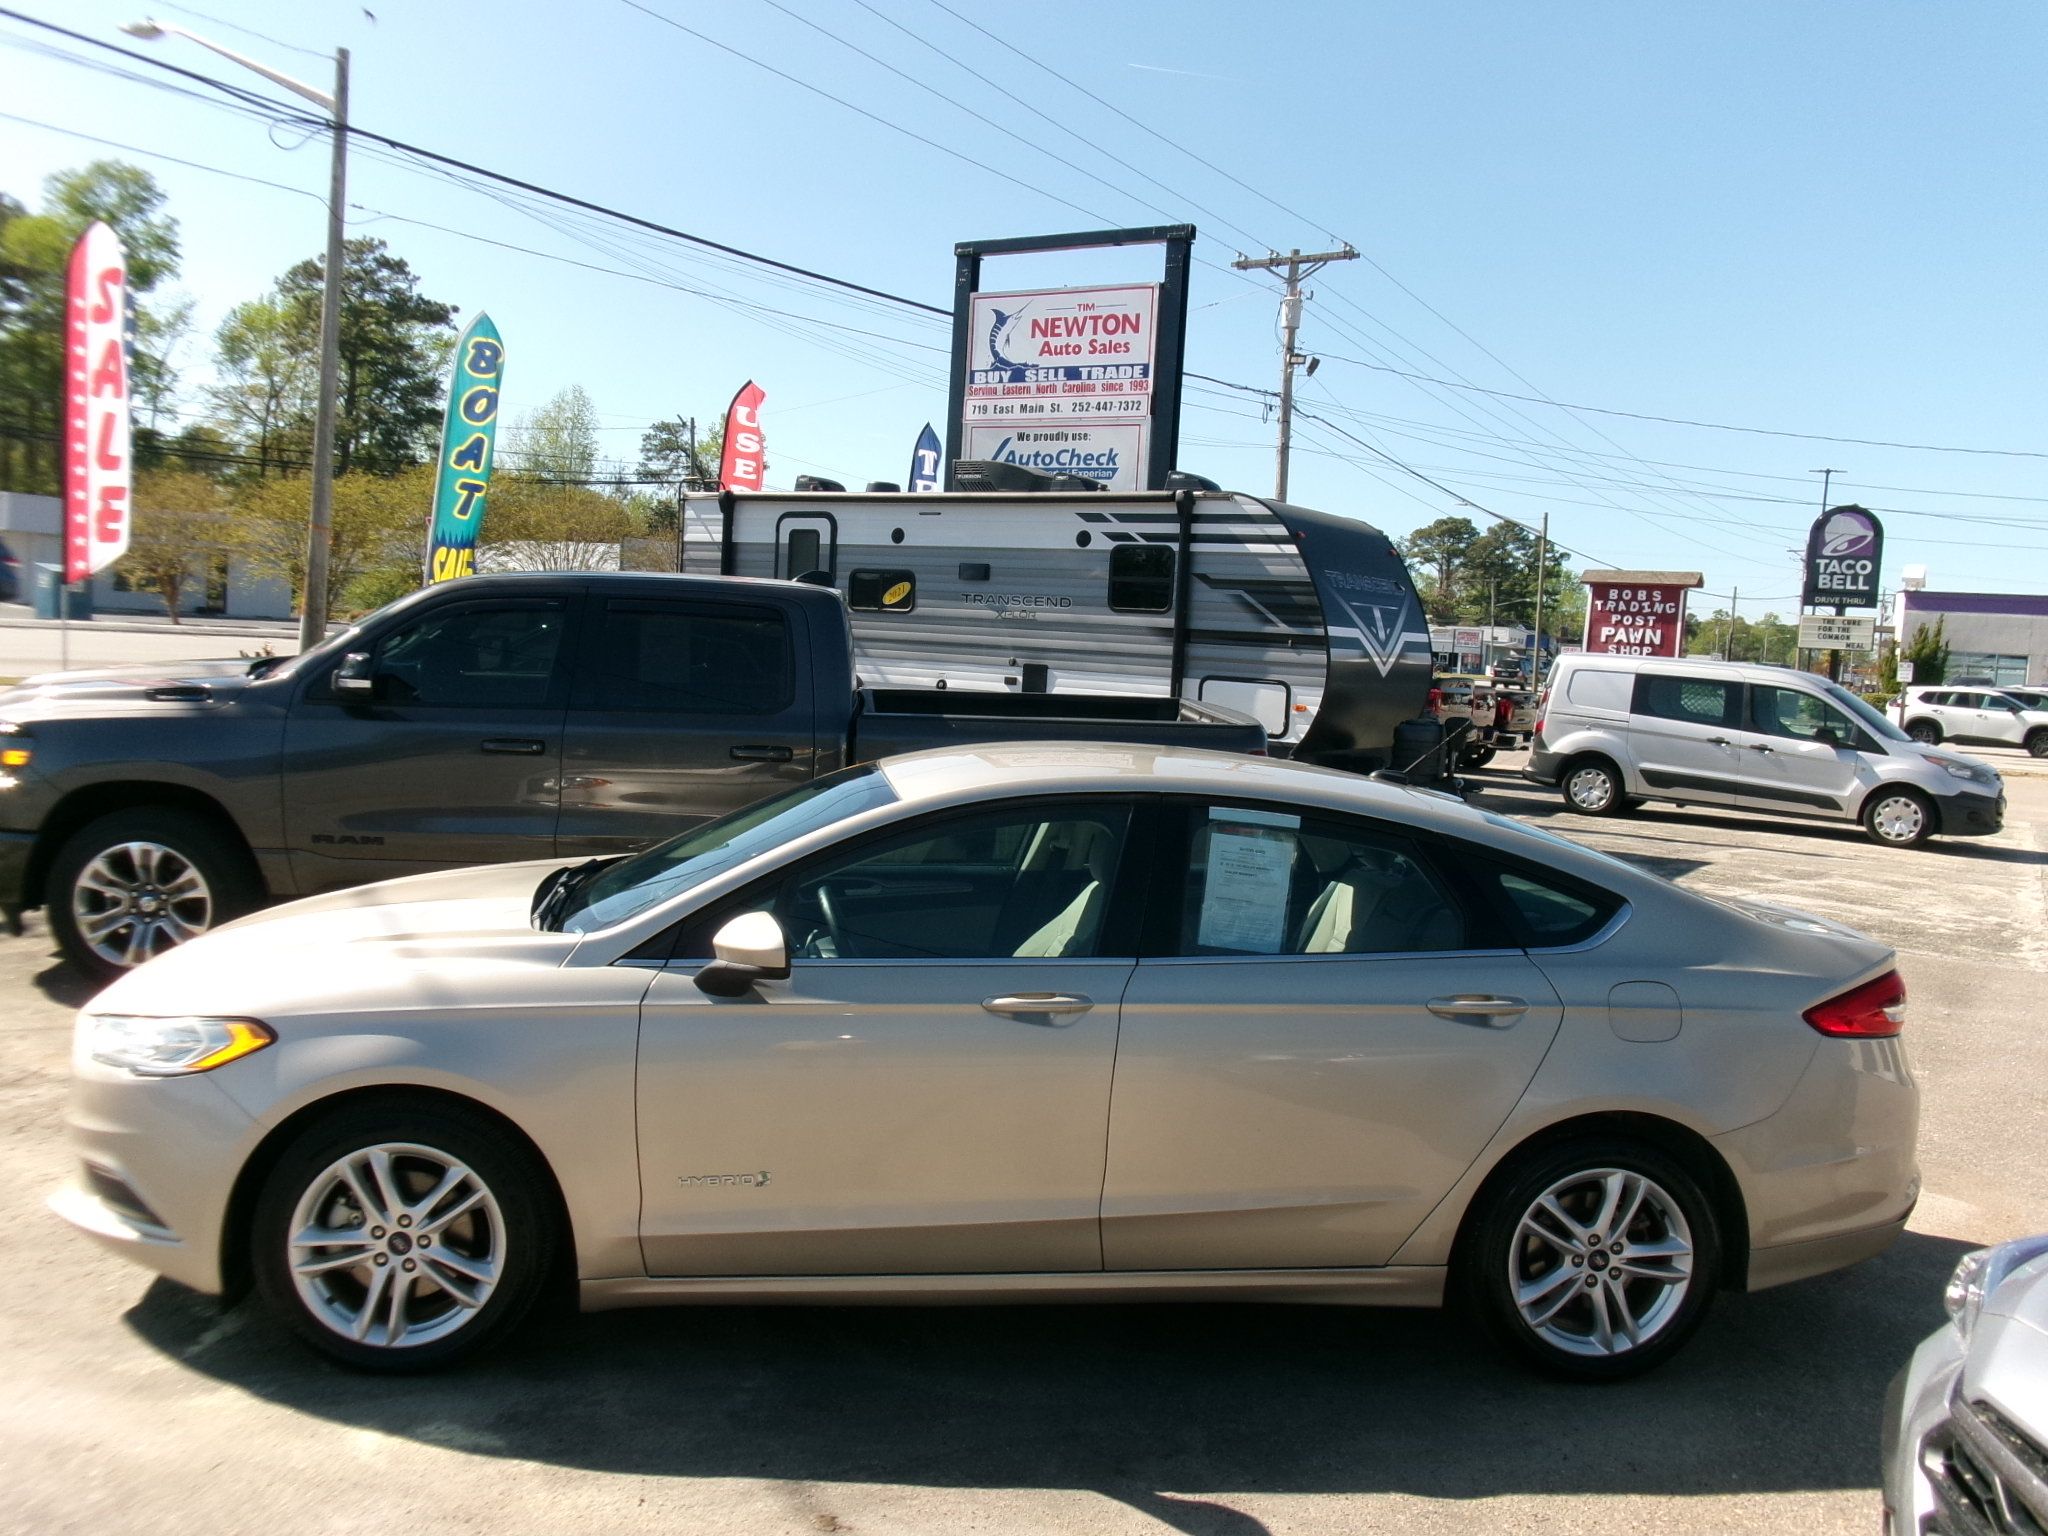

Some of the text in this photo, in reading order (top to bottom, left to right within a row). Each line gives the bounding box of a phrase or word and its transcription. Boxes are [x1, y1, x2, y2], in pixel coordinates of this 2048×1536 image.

[1077, 303, 1095, 312] TIM
[1031, 313, 1141, 339] NEWTON
[1039, 338, 1130, 357] Auto Sales
[974, 365, 1143, 384] BUY SELL TRADE
[969, 380, 1149, 396] Serving Eastern North Carolina since 1993
[89, 267, 127, 542] SALE
[972, 400, 1142, 415] 719 East Main St. 252-447-7372
[451, 337, 502, 520] BOAT
[1017, 431, 1091, 442] We proudly use:
[729, 405, 762, 491] USE
[1004, 447, 1120, 467] AutoCheck
[1815, 558, 1873, 575] TACO
[1818, 574, 1870, 590] BELL
[961, 593, 1073, 608] TRANSCEND
[1609, 589, 1662, 601] BOBS
[1814, 596, 1866, 605] DRIVE THRU
[1594, 600, 1676, 614] TRADING
[1611, 614, 1657, 627] POST
[1600, 626, 1662, 645] PAWN
[1607, 644, 1653, 656] SHOP
[311, 834, 385, 846] RAM
[678, 1174, 755, 1187] HYBRID
